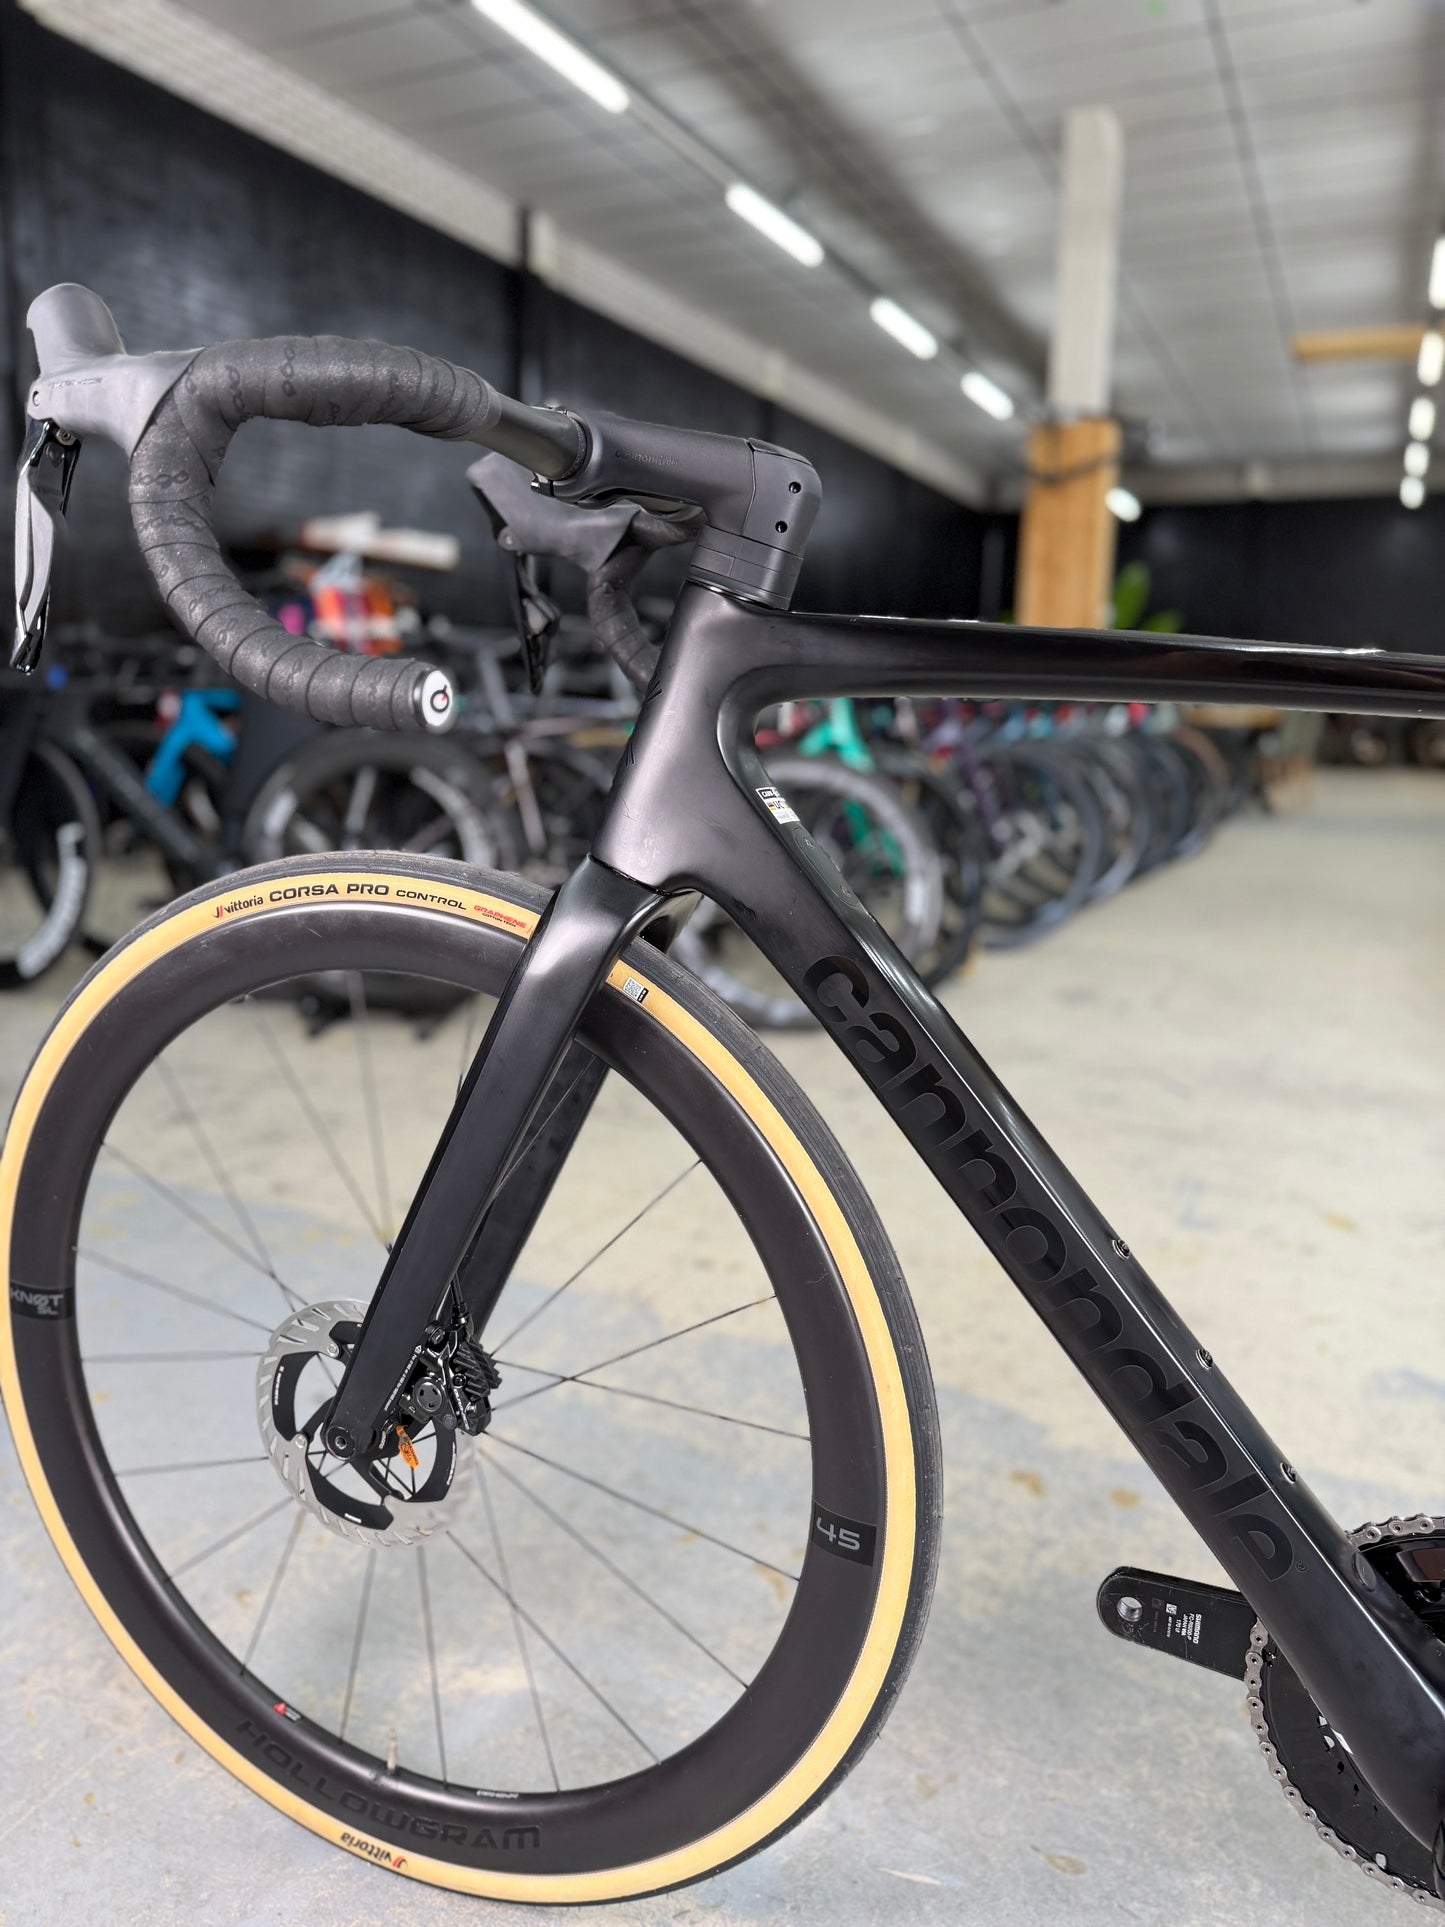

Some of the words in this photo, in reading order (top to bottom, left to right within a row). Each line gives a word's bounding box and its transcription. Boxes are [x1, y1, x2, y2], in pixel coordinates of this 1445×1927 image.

[224, 895, 264, 914] vittoria
[269, 883, 340, 903] CORSA
[347, 883, 390, 896] PRO
[396, 889, 467, 911] CONTROL
[473, 904, 527, 929] GRAPHENE
[802, 954, 1295, 1583] cannondale
[816, 1516, 861, 1551] 45
[236, 1719, 542, 1850] HOLLOWGRAM
[340, 1832, 393, 1862] vittoria
